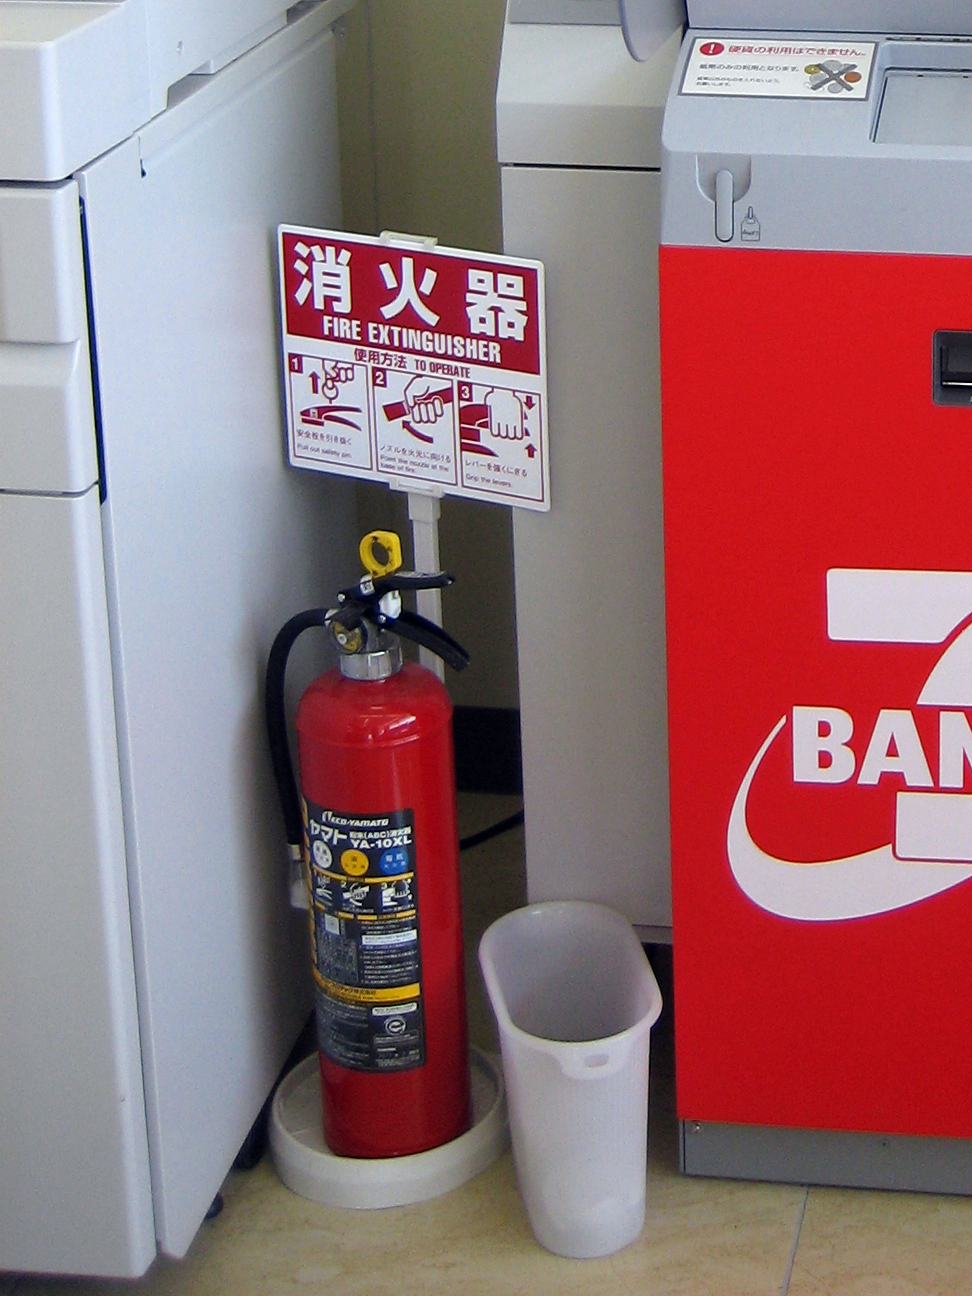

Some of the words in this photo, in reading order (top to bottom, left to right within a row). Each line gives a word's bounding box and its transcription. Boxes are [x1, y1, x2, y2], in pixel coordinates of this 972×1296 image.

[293, 240, 529, 343] 消火器
[322, 315, 362, 342] FIRE
[367, 322, 502, 364] EXTINGUISHER
[353, 347, 408, 370] 使用方法
[413, 357, 428, 372] TO
[428, 360, 472, 380] OPERATE
[374, 371, 385, 385] 2
[460, 385, 472, 399] 3
[309, 818, 348, 846] ヤマト
[350, 835, 413, 850] YA-10XL
